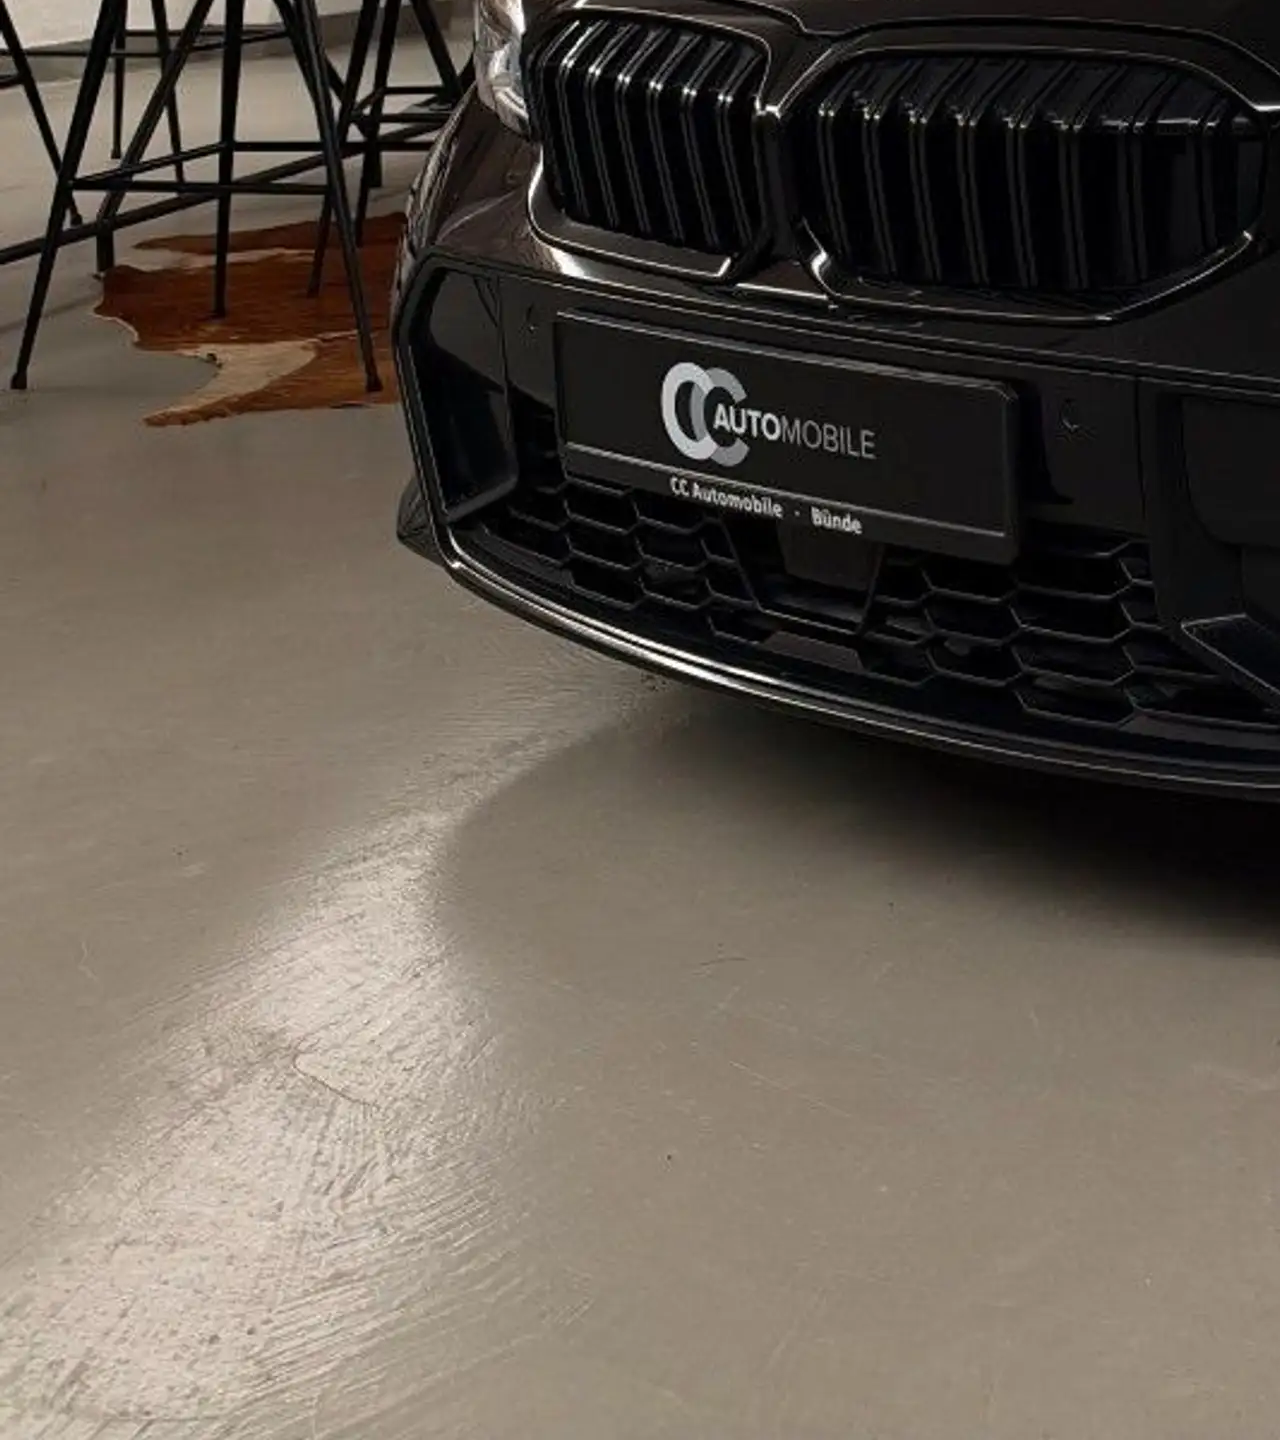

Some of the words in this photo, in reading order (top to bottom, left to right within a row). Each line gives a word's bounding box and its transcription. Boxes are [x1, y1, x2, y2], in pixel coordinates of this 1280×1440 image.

[713, 403, 876, 459] AUTOMOBILE
[669, 476, 690, 495] CC
[692, 484, 783, 519] Automobile
[811, 507, 863, 535] Bünde
